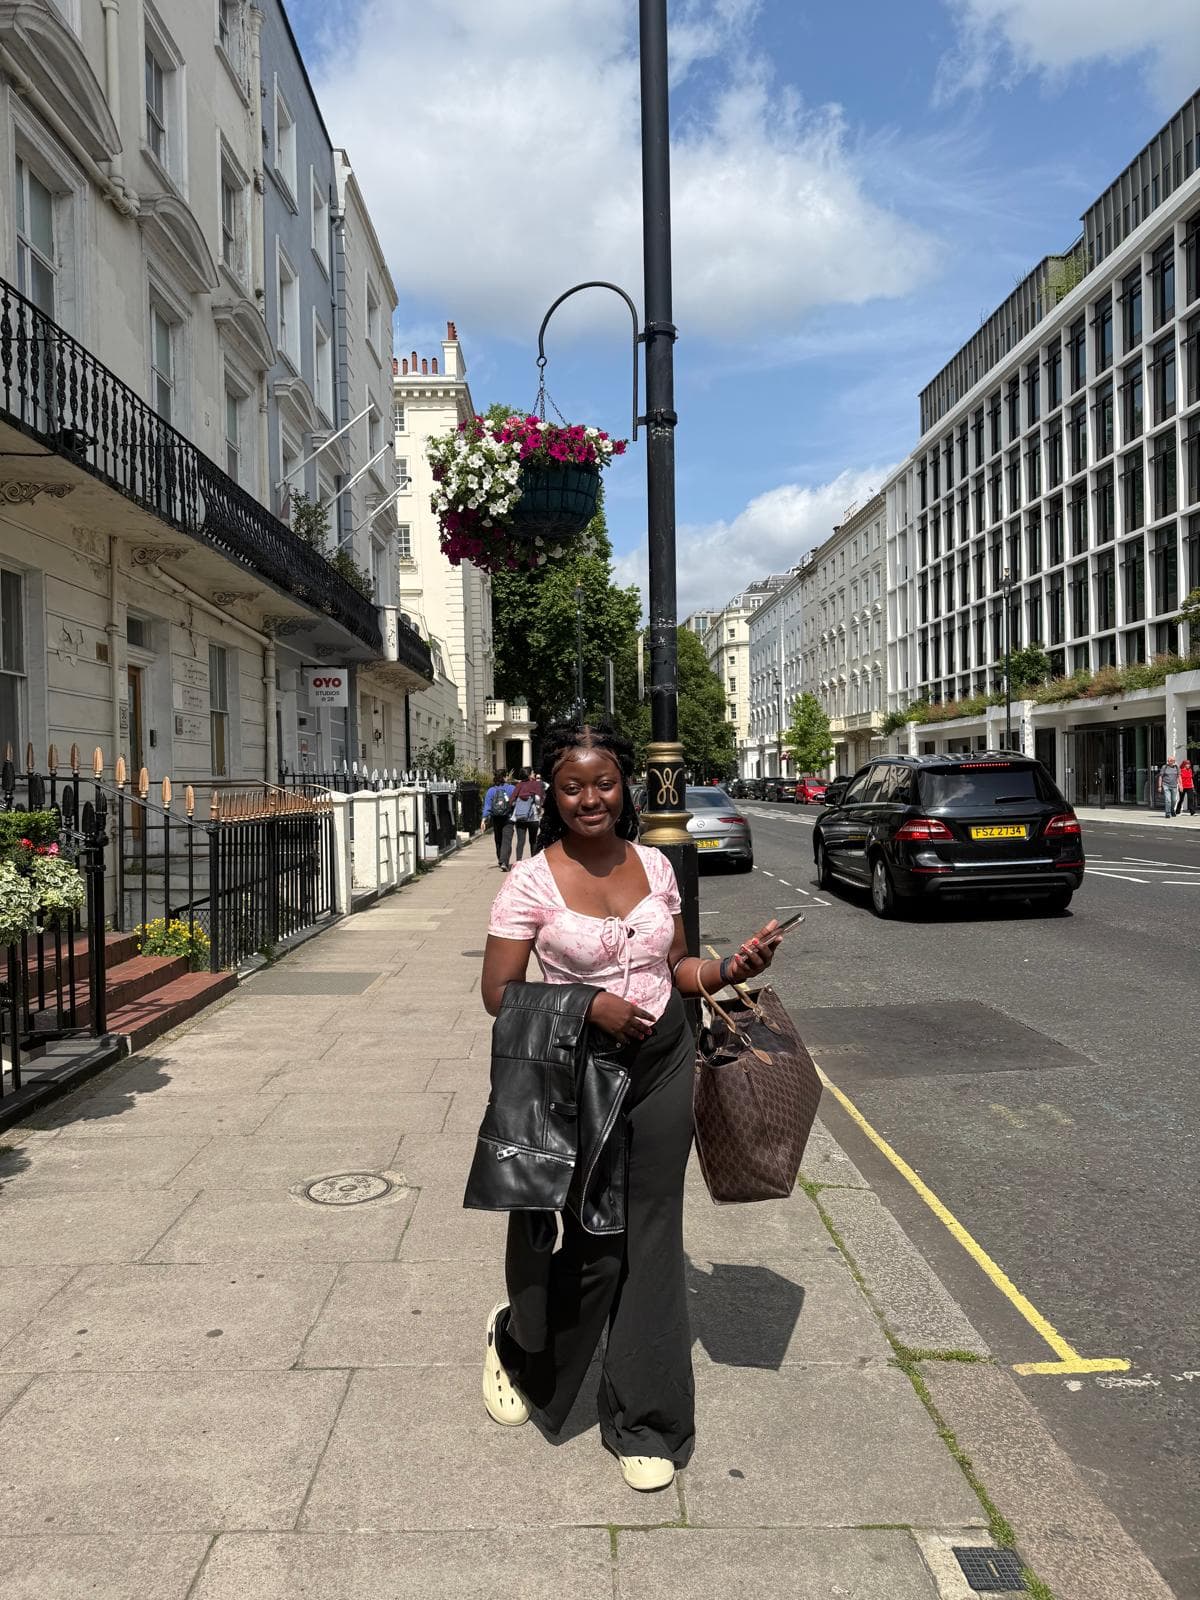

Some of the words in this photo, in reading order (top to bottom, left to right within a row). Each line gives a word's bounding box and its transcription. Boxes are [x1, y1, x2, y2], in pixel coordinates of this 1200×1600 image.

[313, 677, 342, 688] OYO
[975, 827, 995, 837] FSZ
[997, 826, 1021, 836] 2734
